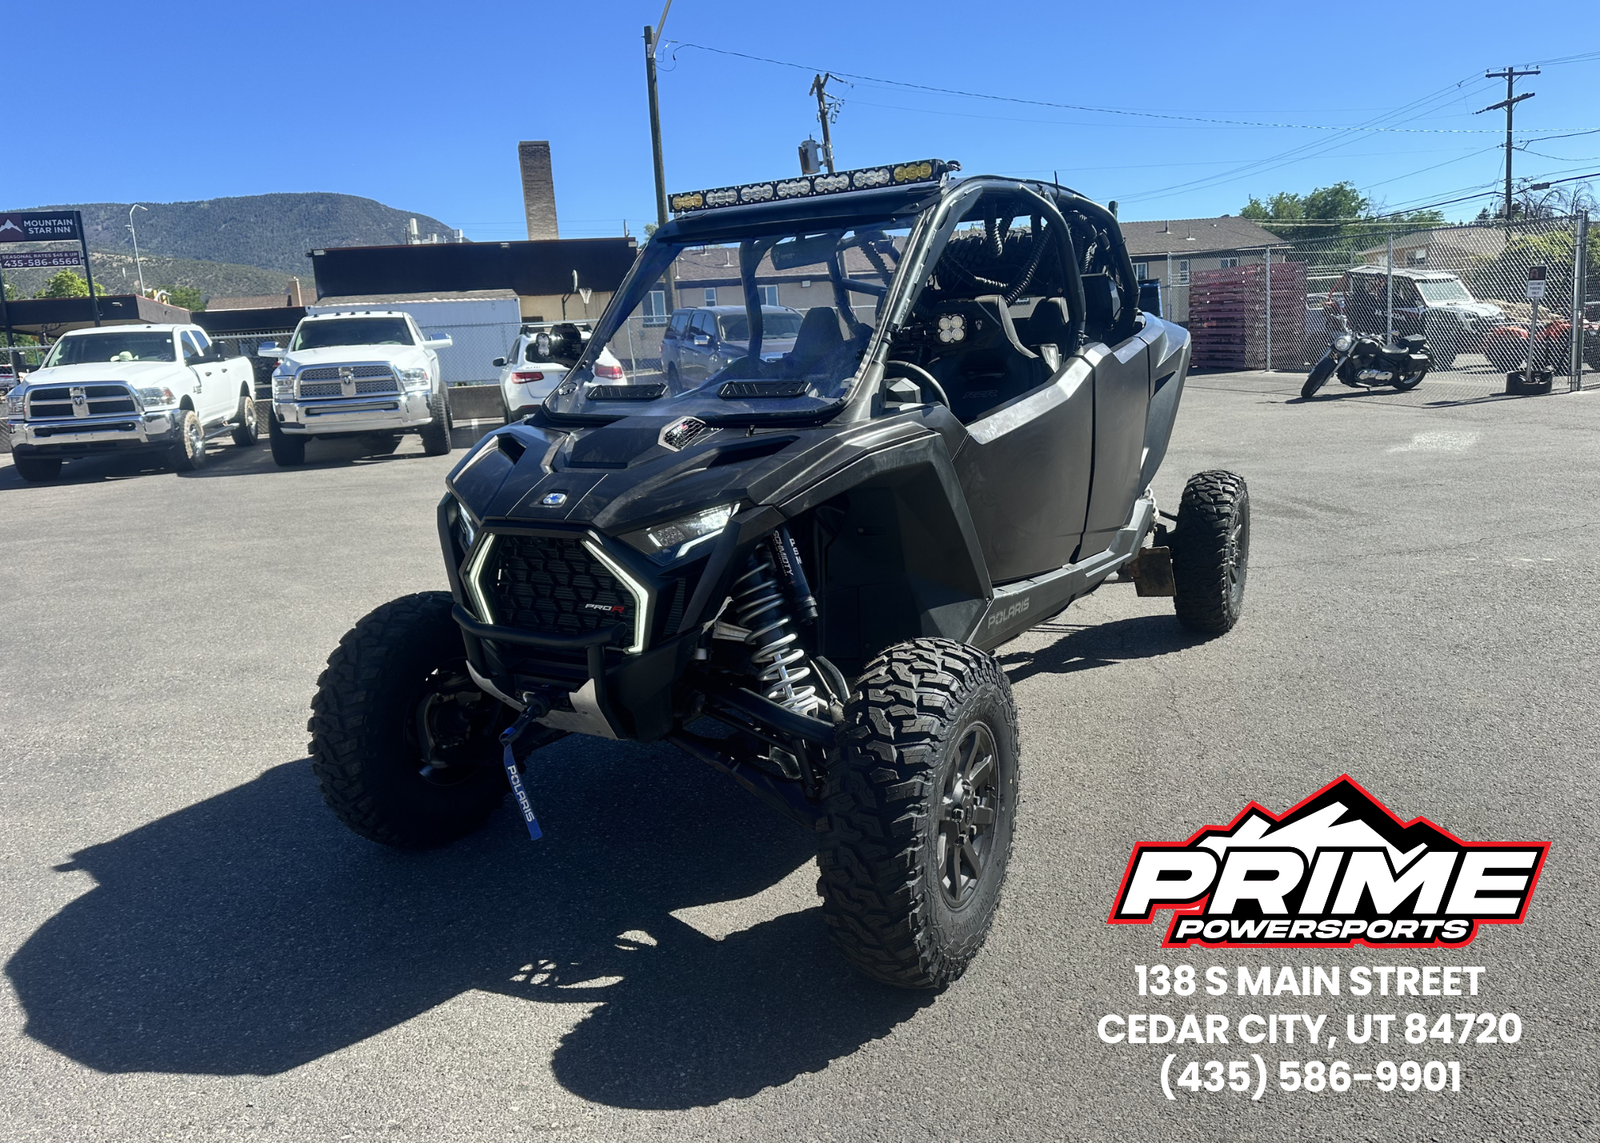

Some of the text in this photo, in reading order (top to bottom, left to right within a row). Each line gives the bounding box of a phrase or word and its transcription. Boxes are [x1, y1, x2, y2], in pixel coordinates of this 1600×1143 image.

[23, 219, 73, 227] MOUNTAIN
[4, 257, 78, 267] 435-586-6566
[773, 530, 794, 576] SCHMIDTY
[988, 597, 1030, 629] POLARIS
[507, 765, 535, 822] POLARIS
